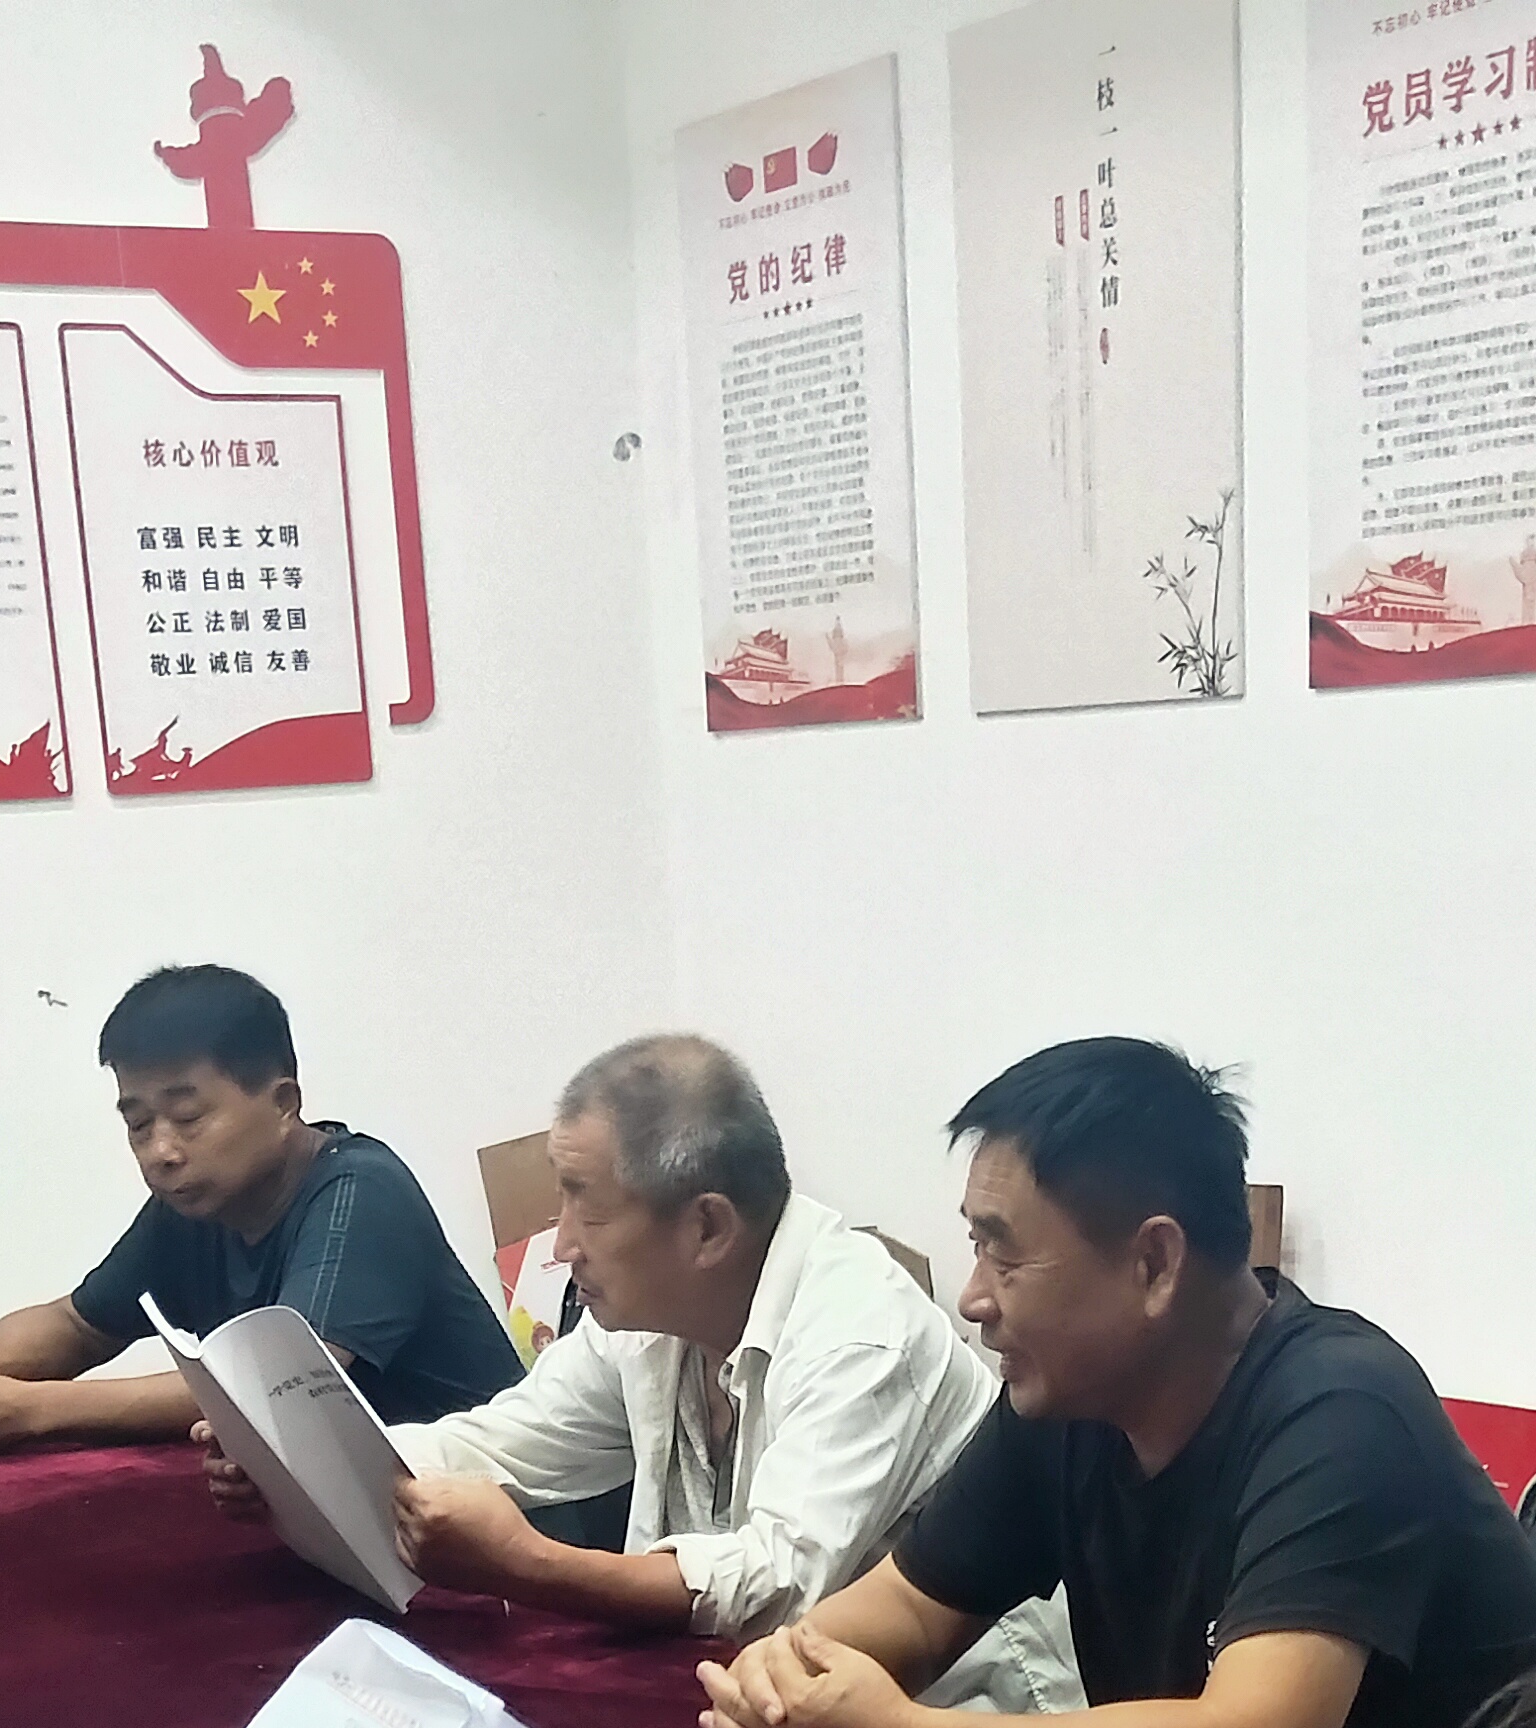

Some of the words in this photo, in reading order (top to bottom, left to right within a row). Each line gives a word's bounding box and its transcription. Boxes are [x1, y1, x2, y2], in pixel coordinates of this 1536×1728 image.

[1372, 9, 1422, 36] 不忘初心
[1097, 45, 1119, 309] 一枝一叶总关情
[728, 233, 847, 304] 党的纪律
[142, 438, 279, 468] 核心价值观
[137, 526, 184, 550] 富强
[197, 525, 243, 549] 民主
[255, 524, 299, 548] 文明
[142, 569, 187, 593] 和谐
[202, 568, 245, 591] 自由
[259, 566, 303, 590] 平等
[146, 611, 193, 634] 公正
[204, 609, 250, 633] 法制
[262, 607, 307, 632] 爱国
[150, 653, 197, 677] 敬业
[209, 651, 253, 674] 诚信
[266, 649, 311, 672] 友善
